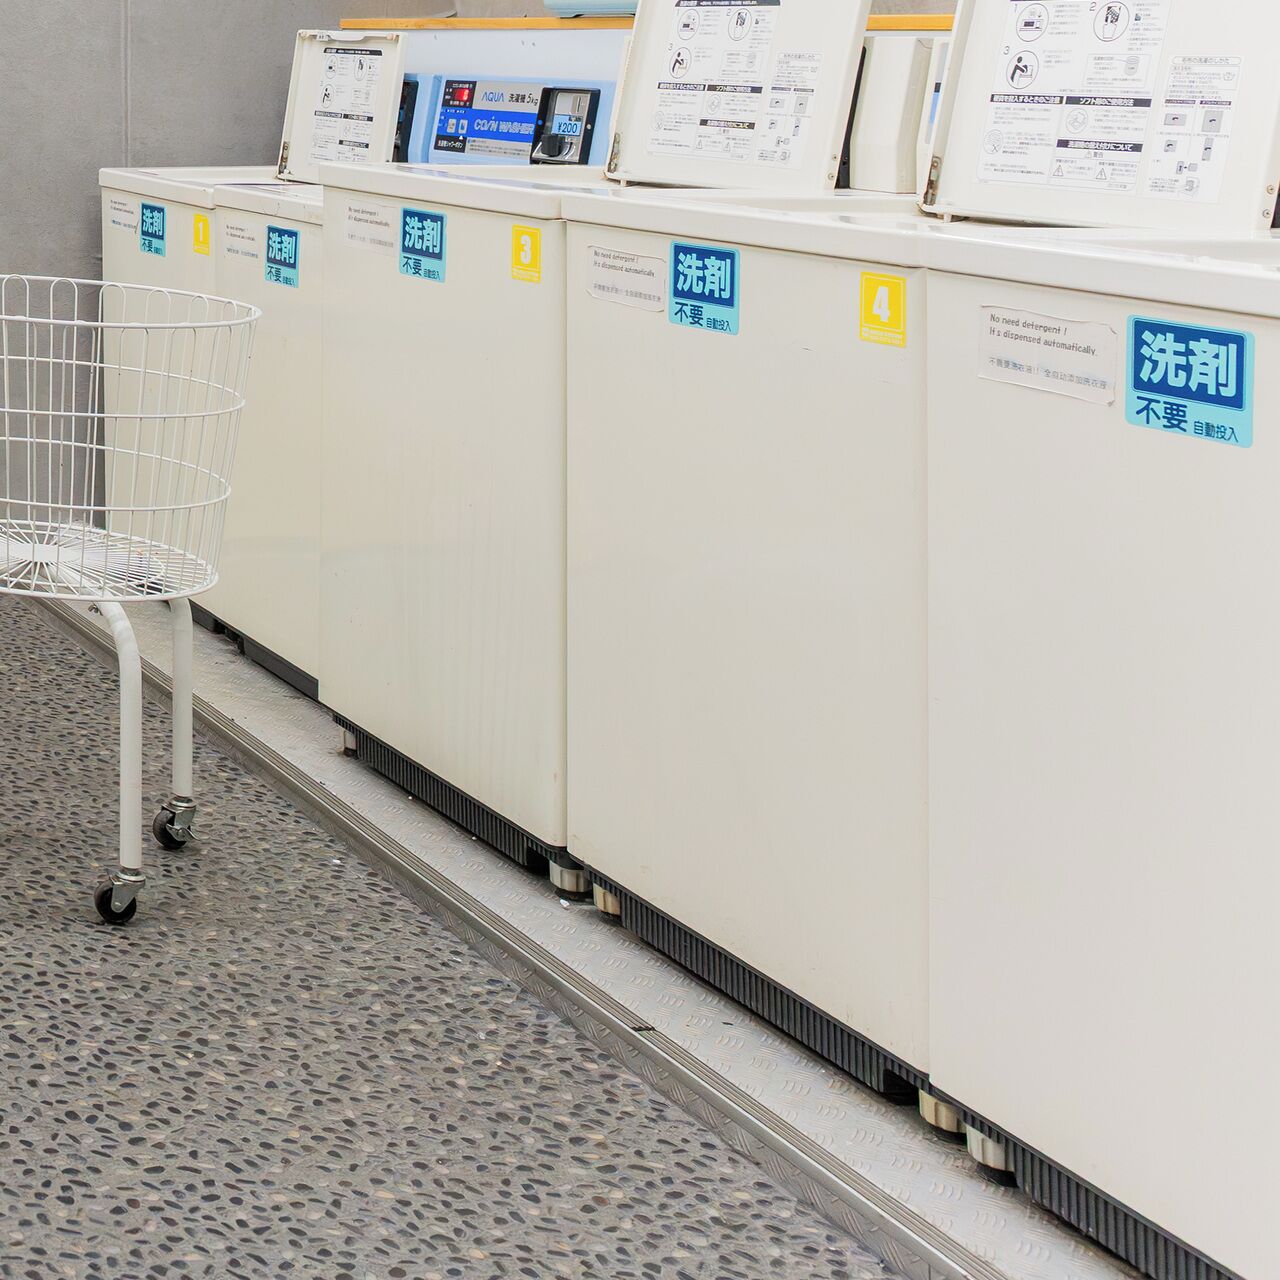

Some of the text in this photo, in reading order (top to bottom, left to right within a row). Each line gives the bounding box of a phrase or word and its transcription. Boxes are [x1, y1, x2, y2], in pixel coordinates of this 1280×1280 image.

[482, 91, 505, 102] AQUA
[508, 93, 526, 104] 洗濯機
[474, 117, 497, 132] COIN
[557, 122, 578, 134] ¥200
[142, 208, 163, 236] 洗剤
[198, 221, 204, 242] 1
[141, 237, 153, 253] 不要
[404, 215, 440, 254] 洗剤
[268, 231, 296, 264] 洗剤
[520, 234, 532, 265] 3
[267, 264, 282, 283] 不要
[402, 255, 422, 277] 不要
[676, 252, 732, 299] 洗剤
[674, 301, 704, 327] 不要
[872, 285, 891, 323] 4
[706, 317, 732, 332] 自動投入
[990, 313, 1000, 323] No
[1002, 317, 1020, 327] need
[1022, 321, 1061, 334] detergent
[1003, 329, 1041, 344] dispensed
[1140, 330, 1237, 398] 洗剤
[1135, 396, 1188, 433] 不要
[1193, 421, 1239, 443] 自動投入
